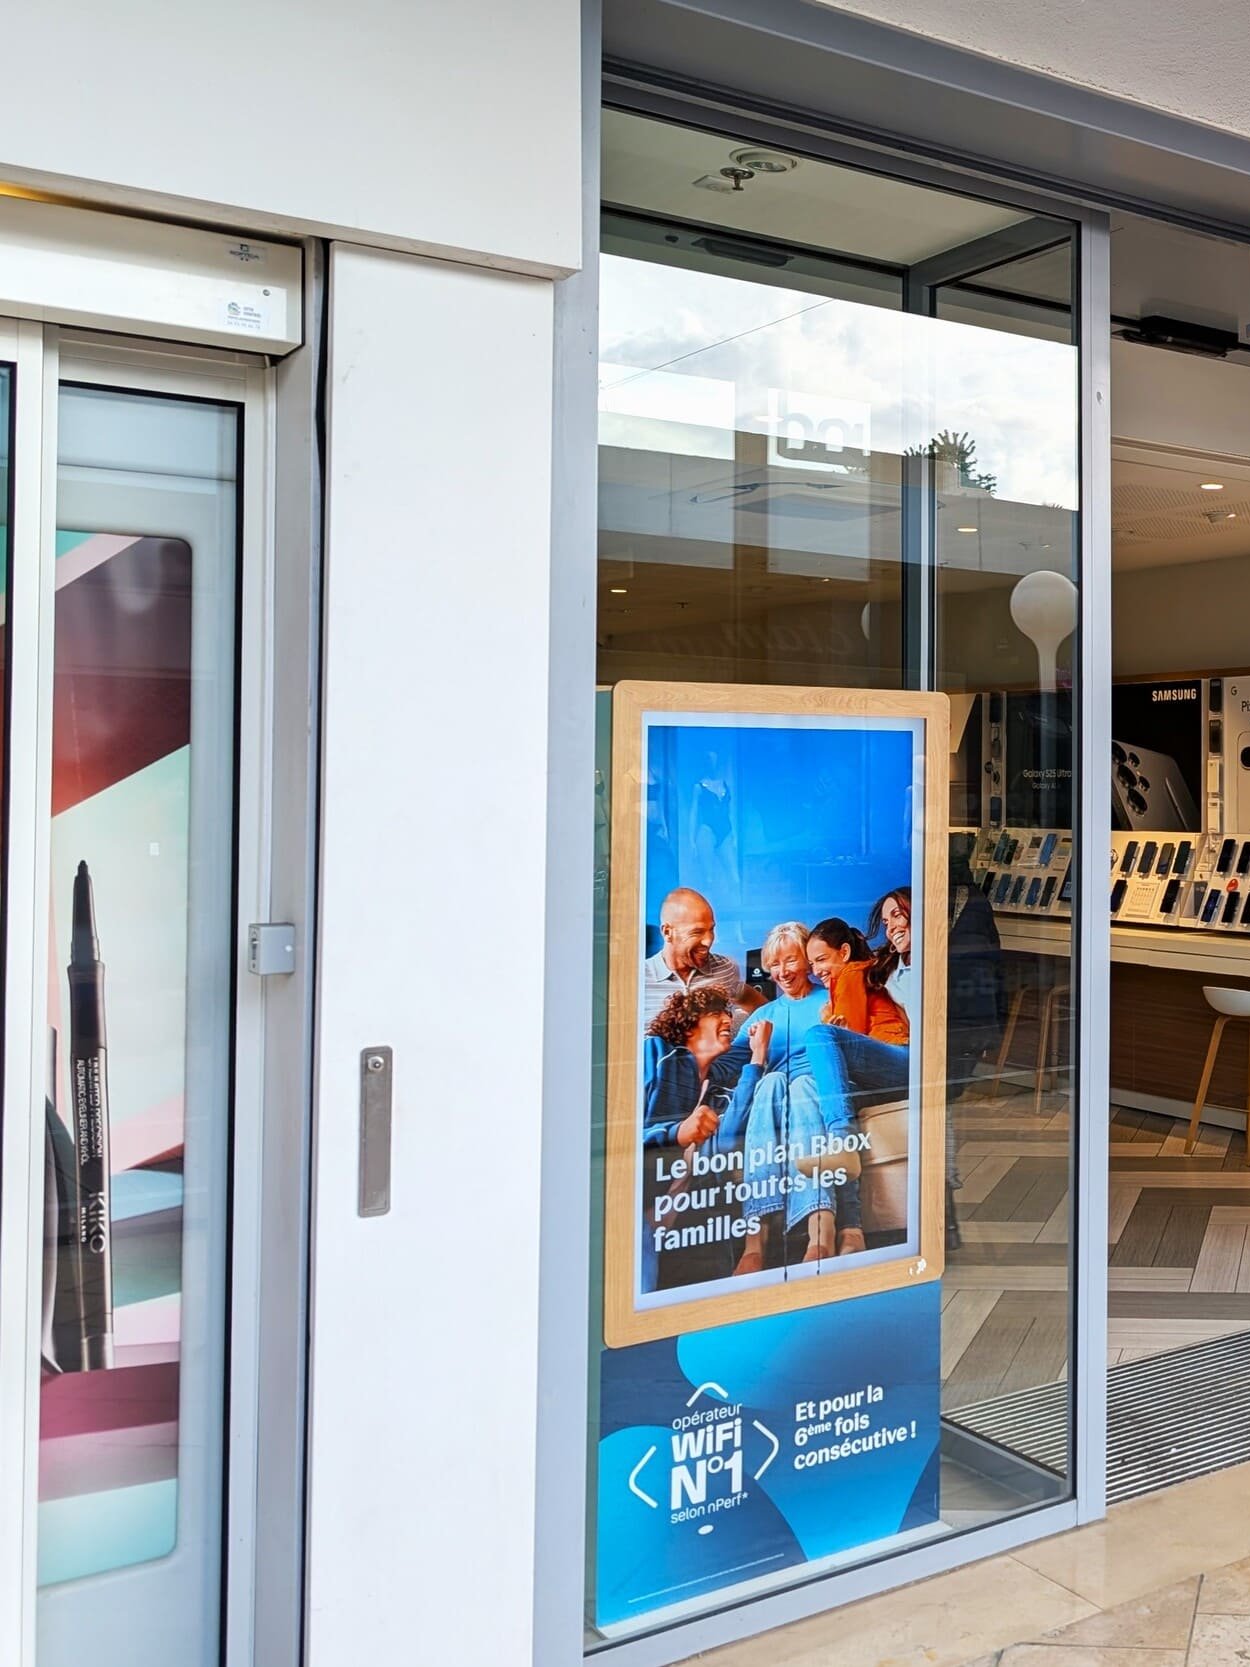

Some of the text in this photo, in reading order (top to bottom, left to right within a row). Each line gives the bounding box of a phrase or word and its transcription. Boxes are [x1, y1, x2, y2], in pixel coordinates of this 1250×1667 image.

[1152, 688, 1197, 702] SAMSUNG
[1023, 769, 1045, 780] Galaxy
[656, 1131, 872, 1182] Le bon plan Bbox
[654, 1166, 847, 1222] pour toutes les
[89, 1191, 105, 1254] KIKO
[654, 1215, 761, 1253] familles
[672, 1403, 742, 1431] opérateur
[796, 1385, 883, 1422] Et pour la
[671, 1417, 742, 1462] WiFi
[835, 1412, 870, 1436] fois
[793, 1420, 917, 1470] consécutive !
[671, 1505, 705, 1524] selon
